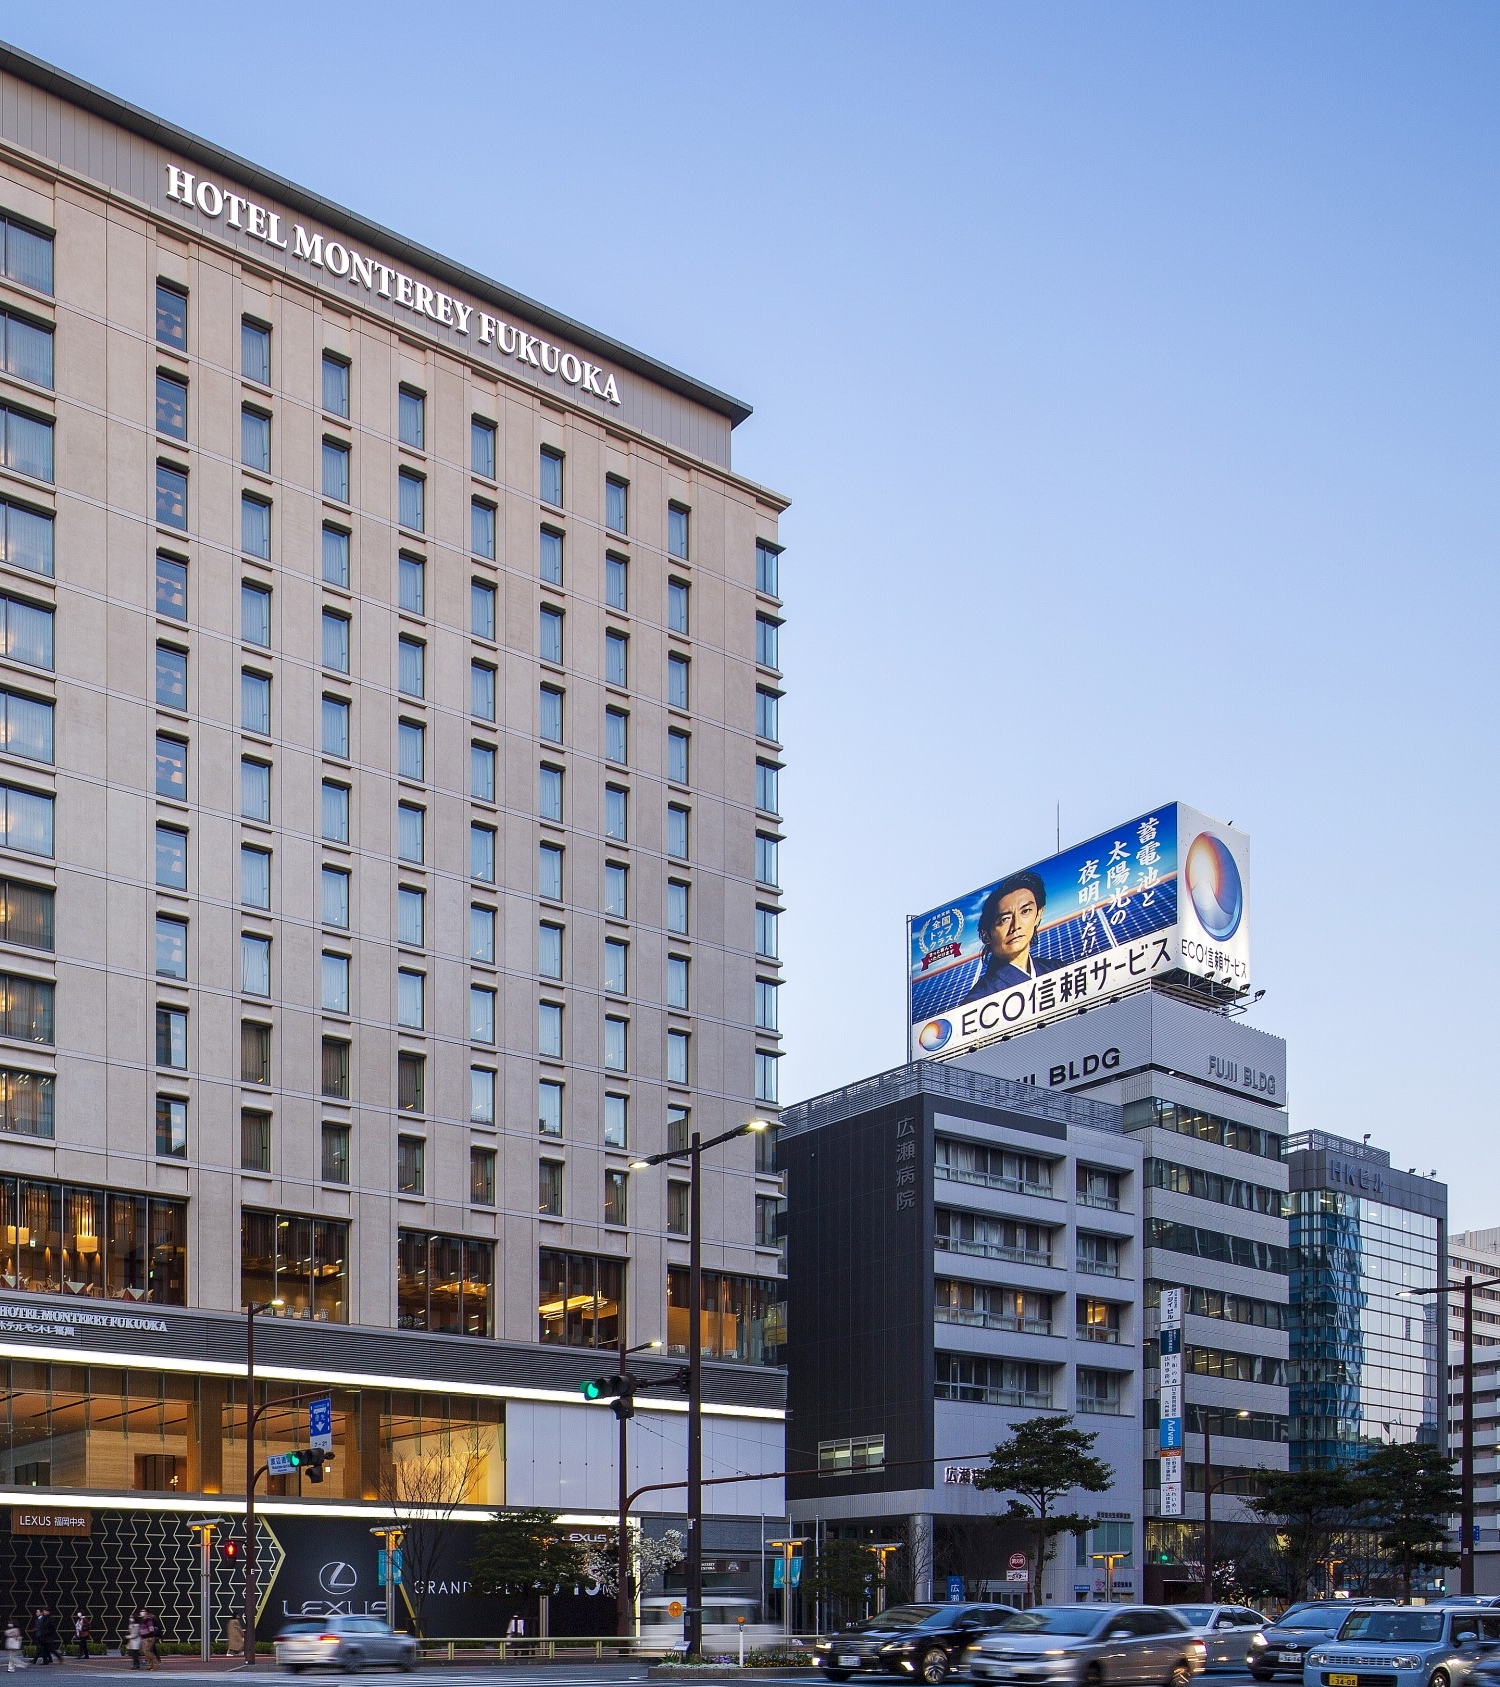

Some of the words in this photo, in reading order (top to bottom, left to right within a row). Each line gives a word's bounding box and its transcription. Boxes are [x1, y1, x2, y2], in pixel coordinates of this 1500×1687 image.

[165, 164, 288, 250] HOTEL
[293, 225, 473, 335] MONTEREY
[478, 311, 621, 406] FUKUOKA
[1136, 817, 1161, 907] 蓄電池と
[1106, 840, 1131, 925] 太陽光の
[930, 923, 953, 940] トップ
[932, 914, 951, 930] 全国
[929, 935, 953, 950] クラス
[1181, 938, 1247, 979] ECO信頼サービス
[961, 938, 1171, 1037] ECO信頼サービス
[1049, 1047, 1121, 1086] BLDG
[1208, 1054, 1238, 1083] FUJII
[1242, 1066, 1276, 1095] BLDG
[896, 1116, 915, 1212] 広瀬病院
[41, 1310, 111, 1326] MONTEREY
[111, 1316, 168, 1332] FUKUOKA
[19, 1515, 52, 1526] LEXUS
[54, 1516, 86, 1527] 福岡中央
[414, 1580, 473, 1594] GRAND
[282, 1600, 387, 1617] LEXUS
[1335, 1678, 1356, 1686] 34-08
